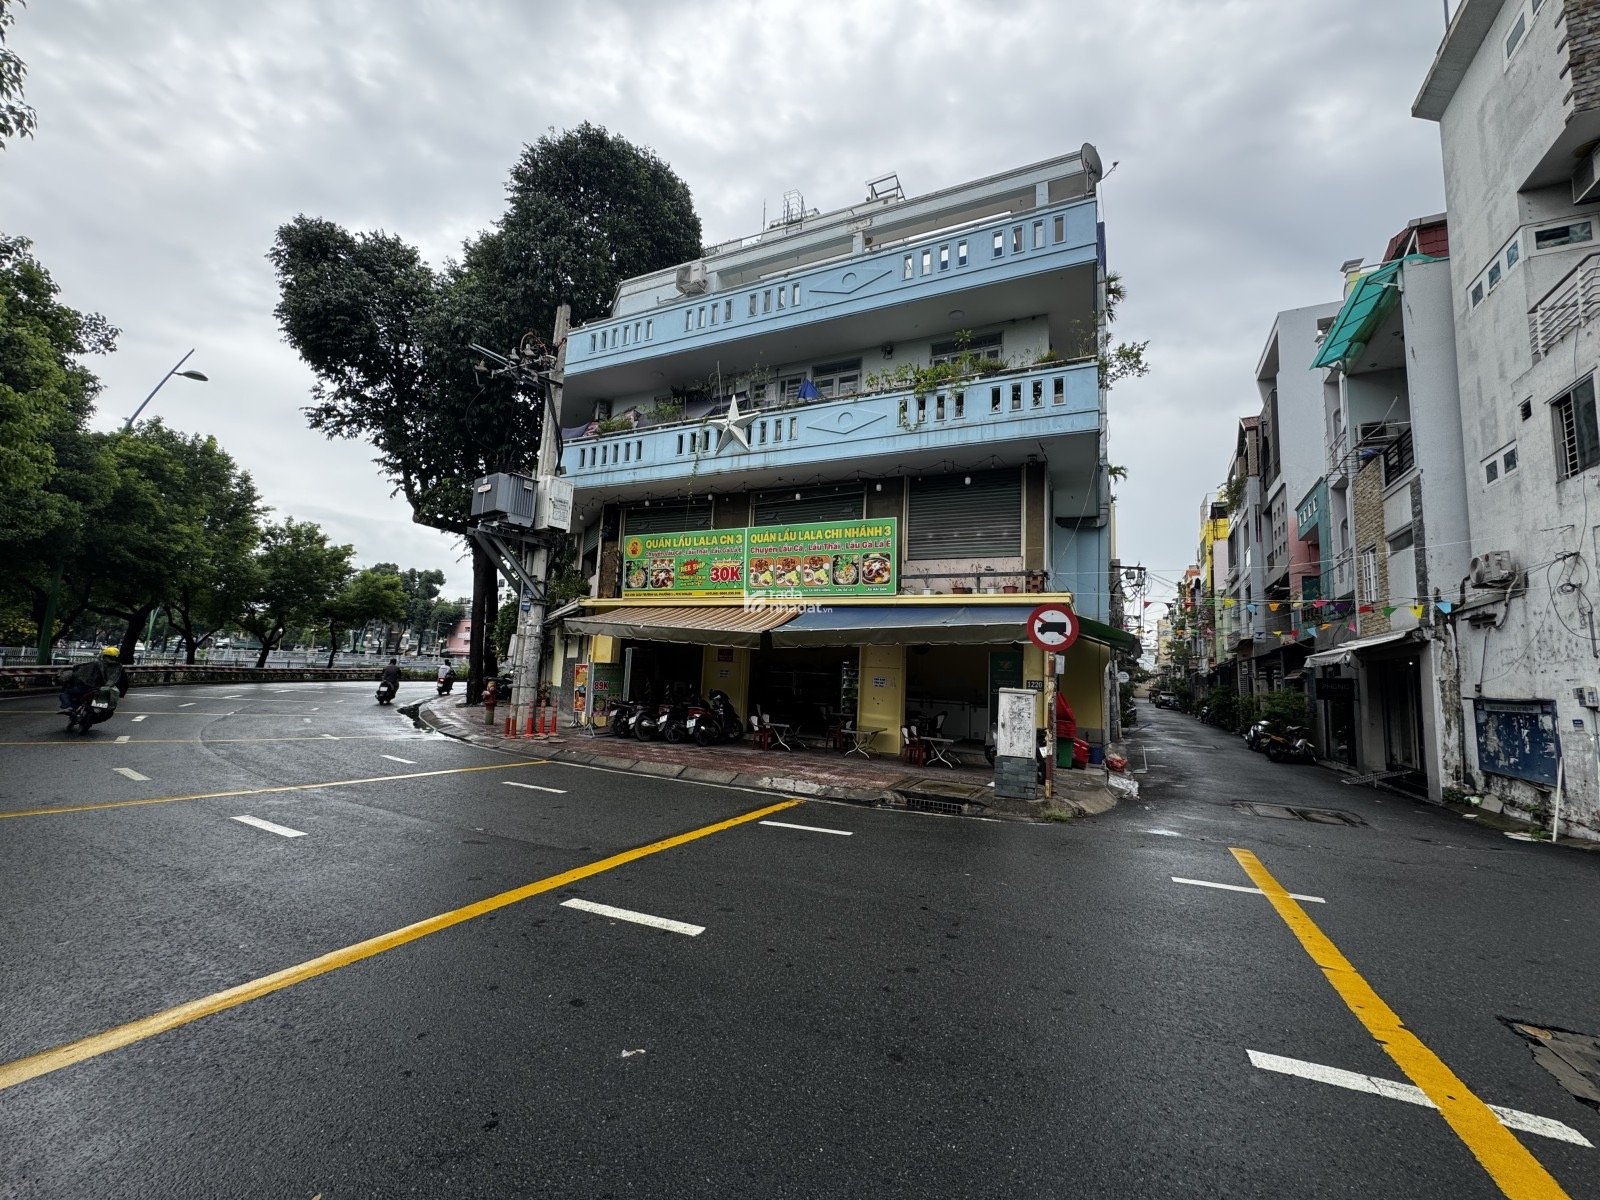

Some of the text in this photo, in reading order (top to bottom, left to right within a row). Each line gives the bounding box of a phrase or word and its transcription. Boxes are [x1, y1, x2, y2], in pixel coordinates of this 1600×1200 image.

[799, 529, 823, 541] LALA
[824, 528, 843, 539] CHI
[845, 524, 882, 538] NHÁNH
[884, 525, 892, 536] 3
[694, 536, 718, 547] LALA
[720, 534, 734, 545] CN
[736, 534, 743, 544] 3
[709, 565, 742, 583] 30K
[594, 681, 609, 691] 89K
